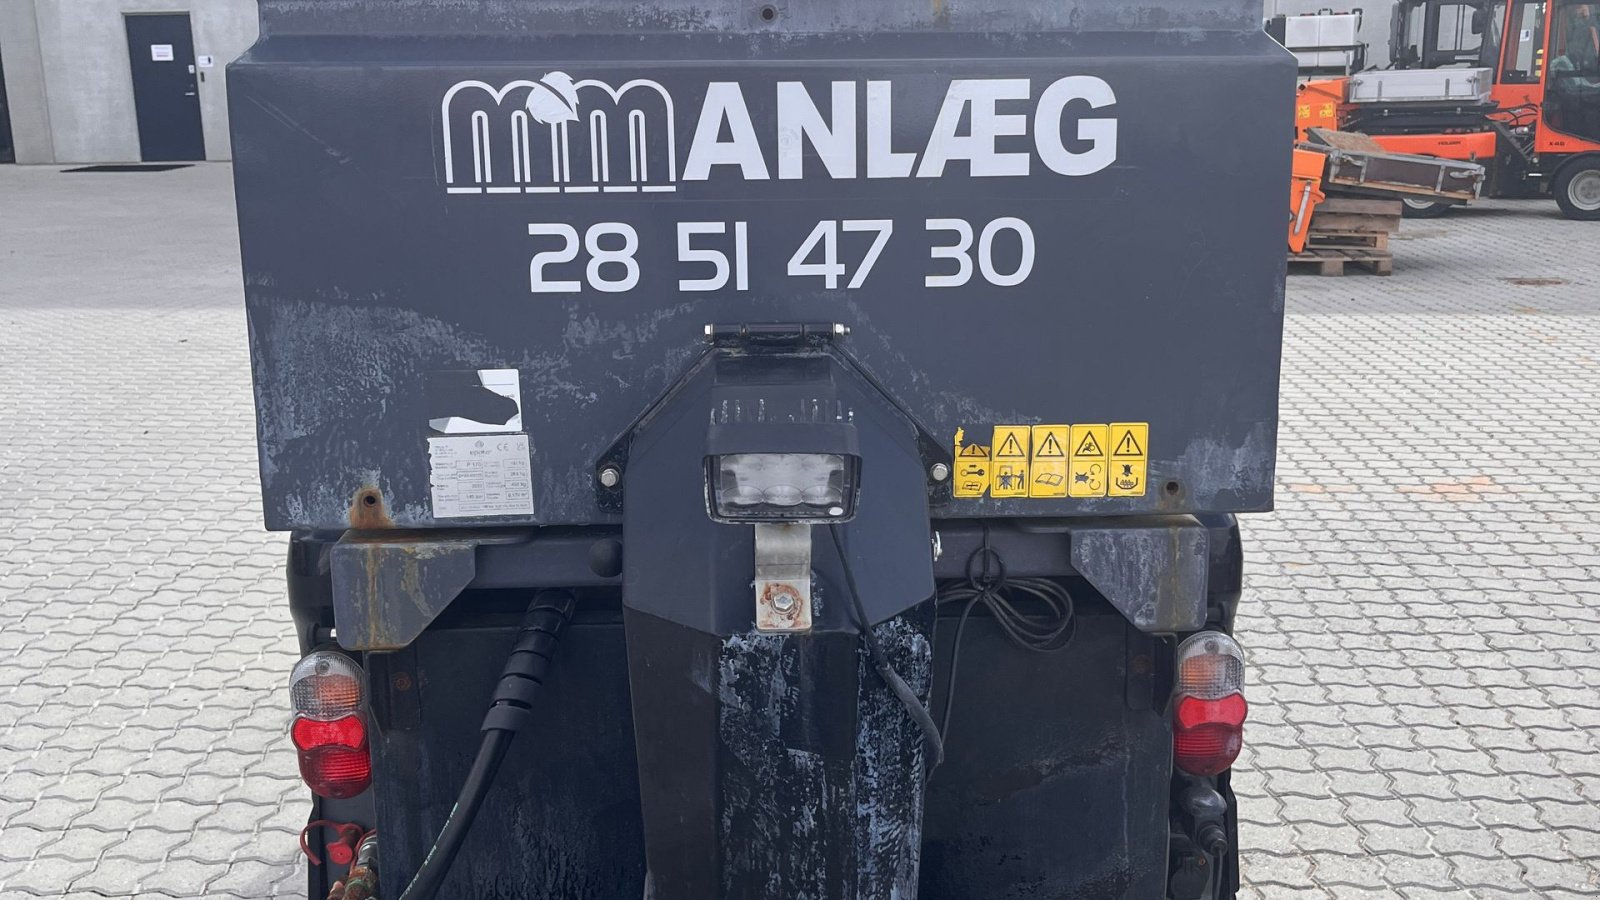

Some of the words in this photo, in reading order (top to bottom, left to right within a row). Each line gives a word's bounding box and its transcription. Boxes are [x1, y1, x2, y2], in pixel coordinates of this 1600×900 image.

[682, 76, 1117, 180] ANLÆG
[529, 223, 639, 292] 28
[677, 222, 748, 291] 51
[788, 220, 892, 289] 47
[925, 217, 1035, 287] 30
